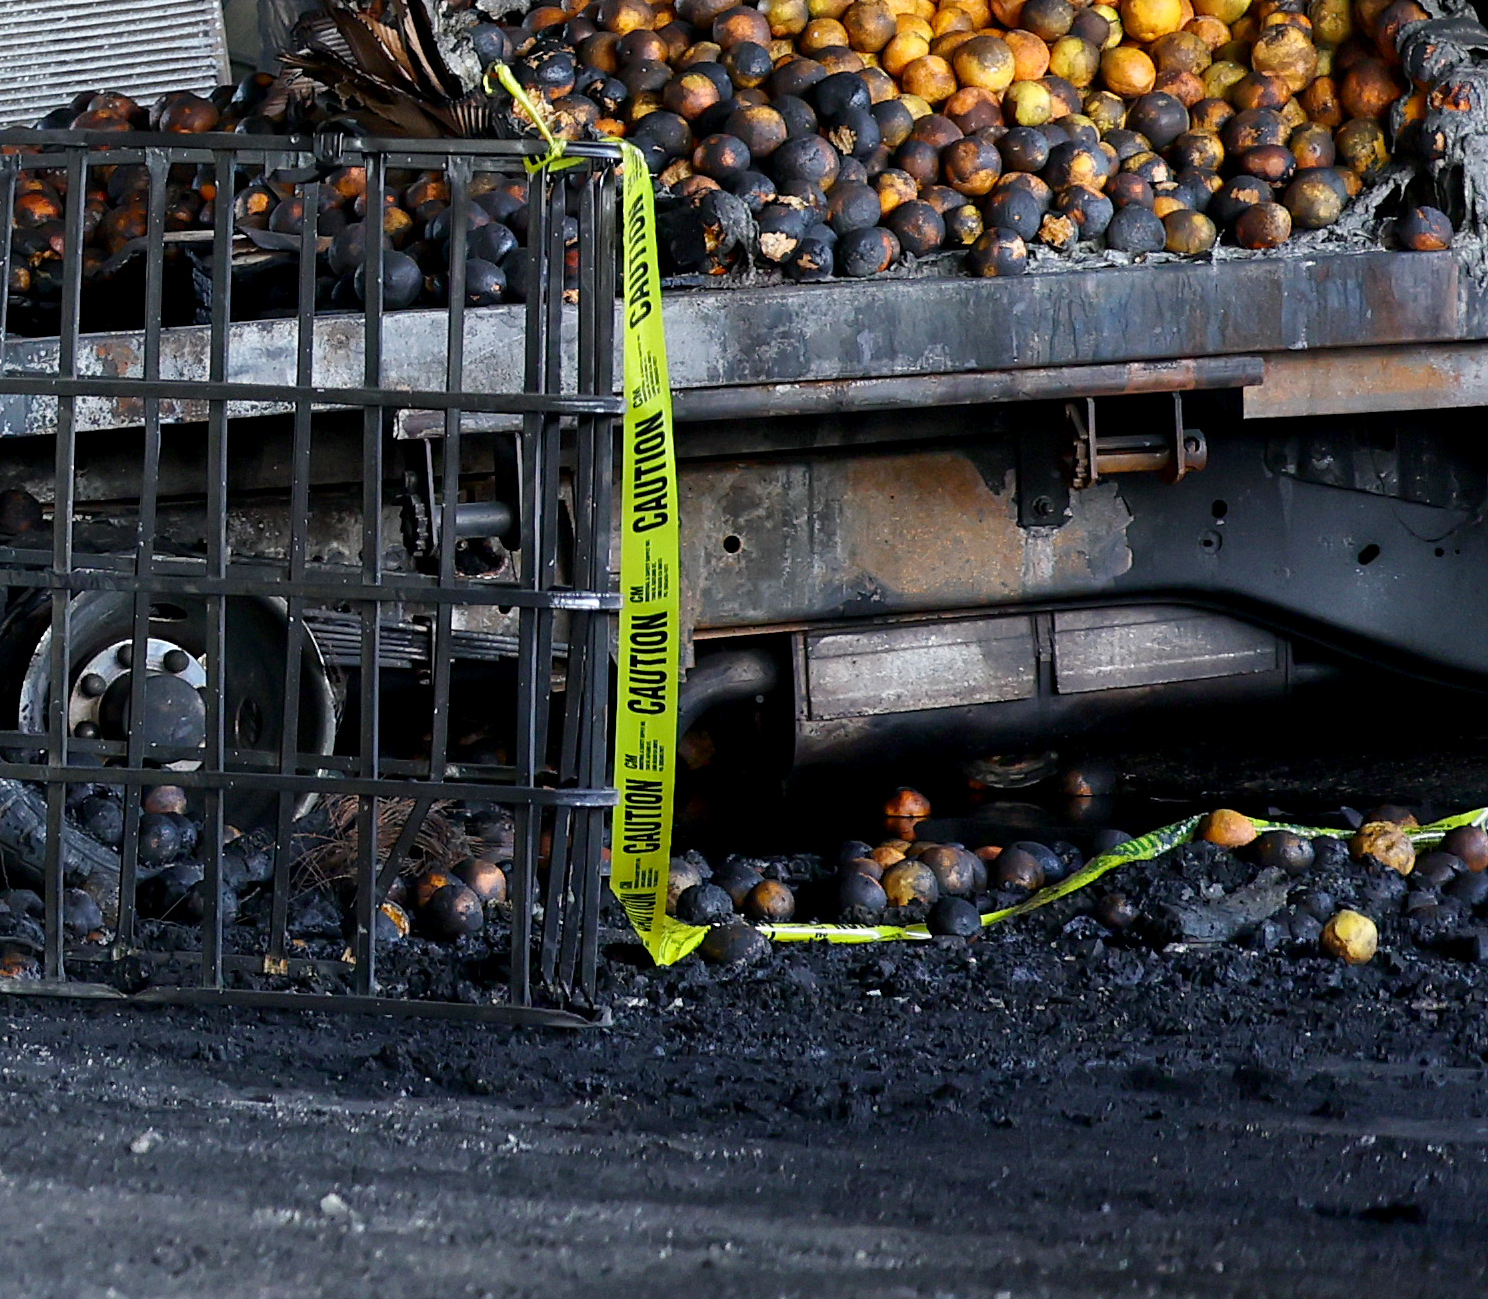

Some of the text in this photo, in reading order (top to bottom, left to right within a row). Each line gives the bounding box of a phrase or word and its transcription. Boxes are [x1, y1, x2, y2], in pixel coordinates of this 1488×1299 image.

[628, 192, 652, 330] CAUTION
[631, 386, 644, 409] CM
[631, 409, 669, 533] CAUTION
[629, 585, 644, 604] CM
[627, 610, 669, 715] CAUTION
[624, 753, 638, 770] CM
[622, 778, 663, 854] CAUTION
